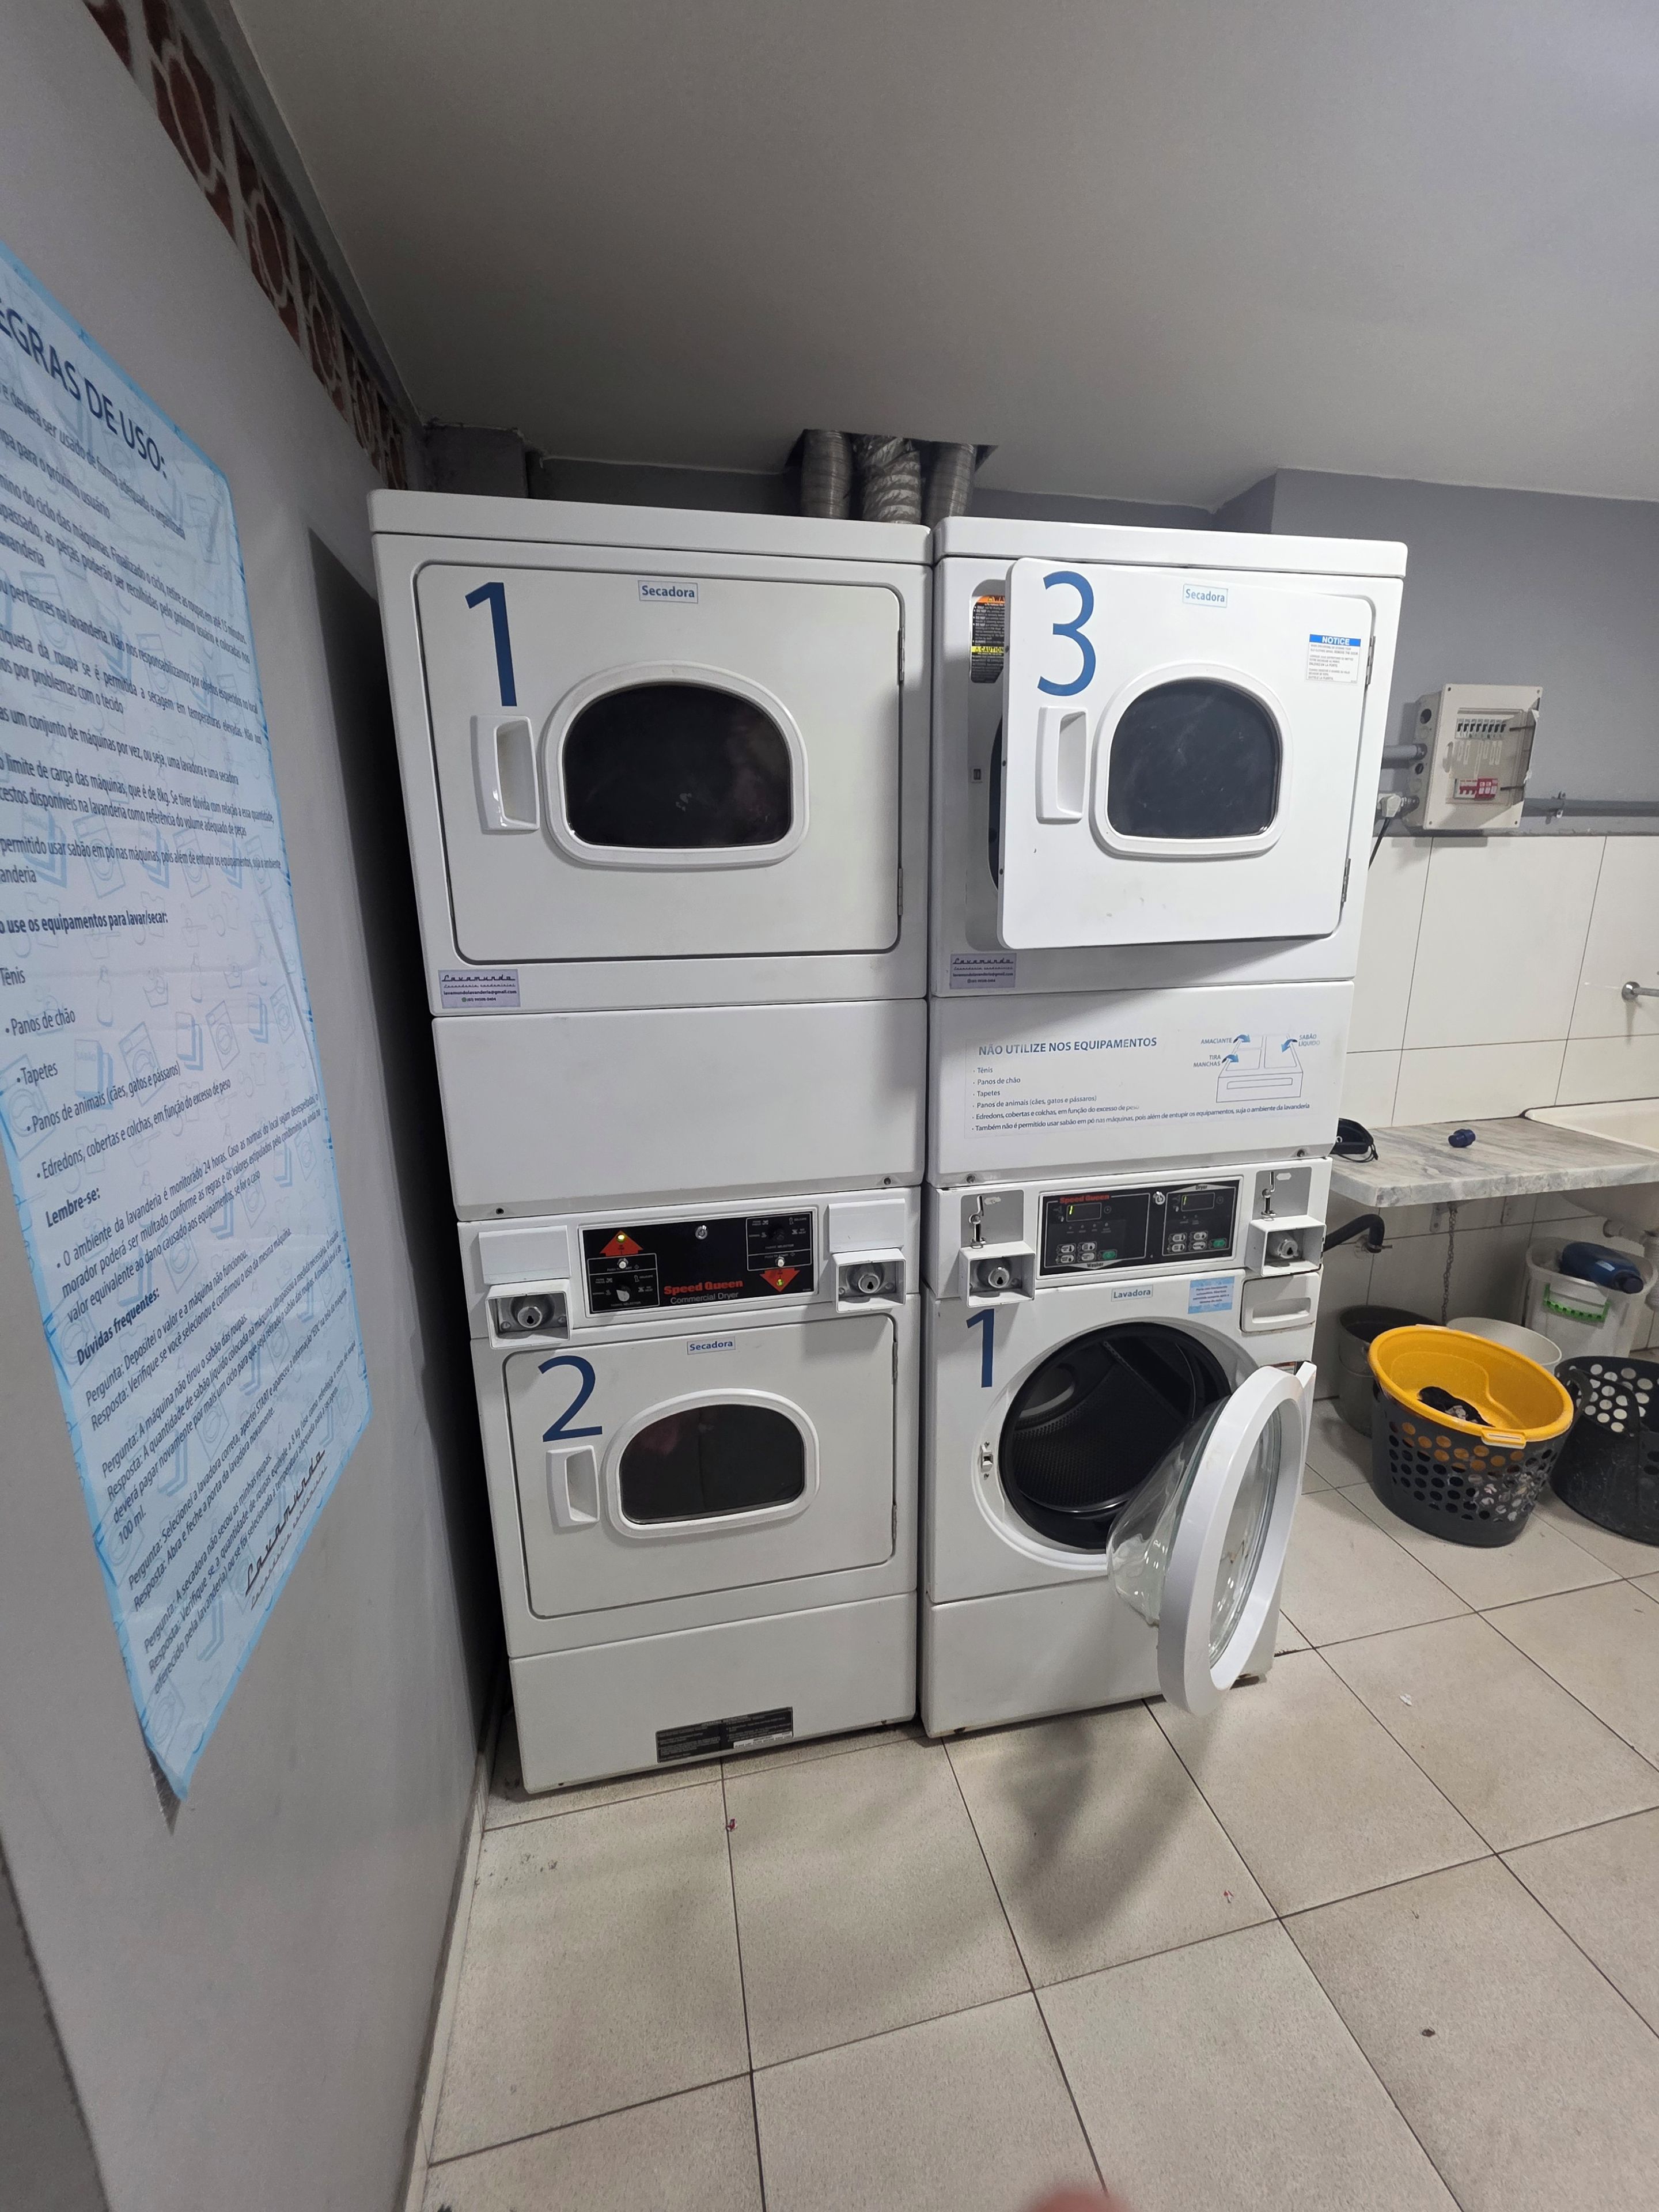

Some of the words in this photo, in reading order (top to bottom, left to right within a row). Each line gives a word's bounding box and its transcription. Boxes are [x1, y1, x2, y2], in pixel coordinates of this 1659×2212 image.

[84, 377, 118, 435] DE
[119, 409, 167, 480] USO:
[642, 585, 695, 599] Secadora
[1185, 588, 1226, 603] Secadora
[464, 581, 518, 707] 1
[1037, 570, 1096, 696] 3
[1322, 636, 1350, 645] NOTICE
[12, 709, 28, 728] um
[29, 715, 67, 738] conjunto
[69, 722, 80, 741] de
[80, 728, 116, 752] máquinas
[116, 741, 128, 756] por
[129, 747, 143, 761] vez,
[143, 749, 152, 762] ou
[152, 751, 166, 768] seja,
[167, 754, 181, 770] uma
[181, 756, 203, 777] lavadora
[203, 766, 207, 777] e
[208, 767, 219, 779] uma
[219, 769, 240, 785] secadora
[5, 752, 35, 777] limite
[36, 759, 48, 779] de
[50, 767, 74, 787] carga
[75, 768, 89, 787] das
[90, 773, 127, 798] máquinas,
[128, 784, 141, 800] que
[142, 783, 147, 798] é
[148, 785, 157, 801] de
[157, 787, 171, 806] 8kg.
[6, 917, 27, 934] use
[29, 918, 40, 932] os
[41, 912, 108, 935] equipamentos
[108, 914, 126, 931] para
[126, 910, 169, 927] lavar/secar:
[0, 965, 26, 987] Tênis
[441, 974, 516, 982] Lavamundo
[10, 1015, 41, 1037] Panos
[42, 1010, 55, 1029] de
[55, 1005, 76, 1027] chão
[979, 1044, 1003, 1056] NÃO
[1005, 1043, 1046, 1055] UTILIZE
[1048, 1041, 1071, 1052] NOS
[1074, 1037, 1157, 1051] EQUIPAMENTOS
[20, 1062, 59, 1088] Tapetes
[32, 1111, 60, 1133] Panos
[62, 1103, 74, 1122] de
[74, 1092, 105, 1116] animais
[107, 1085, 128, 1105] (cães,
[128, 1074, 148, 1098] gatos
[153, 1060, 181, 1088] pássaros)
[977, 1090, 1001, 1098] Tapetes
[1029, 1097, 1046, 1106] (cães,
[1047, 1097, 1063, 1105] gatos
[1069, 1095, 1097, 1104] pássaros)
[976, 1112, 1004, 1120] Edredons,
[1068, 1107, 1087, 1116] função
[1018, 1121, 1046, 1130] permitido
[1087, 1118, 1095, 1126] pó
[1106, 1116, 1134, 1124] máquinas,
[1169, 1111, 1188, 1119] entupir
[1196, 1108, 1234, 1118] equipamentos,
[1236, 1107, 1245, 1115] suja
[41, 1147, 86, 1180] Edredons,
[86, 1130, 120, 1158] cobertas
[120, 1129, 126, 1141] e
[127, 1117, 153, 1138] colchas,
[153, 1110, 164, 1125] em
[164, 1099, 185, 1121] função
[185, 1094, 193, 1109] do
[193, 1087, 213, 1105] excesso
[213, 1081, 219, 1096] de
[219, 1078, 231, 1097] peso
[46, 1187, 101, 1228] Lembre-se:
[63, 1249, 71, 1267] O
[73, 1224, 112, 1261] ambiente
[114, 1217, 125, 1234] da
[125, 1192, 162, 1226] lavanderia
[164, 1186, 168, 1201] é
[169, 1167, 203, 1195] monitorado
[203, 1161, 211, 1175] 24
[211, 1152, 228, 1170] horas.
[1059, 1195, 1084, 1205] Speed
[1084, 1194, 1109, 1202] Queen
[664, 1282, 703, 1296] Speed
[704, 1280, 743, 1290] Queen
[670, 1294, 716, 1305] Commercial
[718, 1291, 739, 1300] Dryer
[1113, 1289, 1152, 1299] Lavadora
[76, 1327, 114, 1366] Dúvidas
[113, 1288, 160, 1334] frequentes:
[85, 1364, 124, 1407] Pergunta:
[123, 1330, 157, 1370] Depositei
[157, 1328, 161, 1339] o
[161, 1312, 177, 1334] valor
[178, 1308, 183, 1319] e
[184, 1302, 188, 1315] a
[188, 1281, 213, 1311] máquina
[213, 1270, 224, 1289] não
[222, 1249, 248, 1278] funcionou.
[690, 1340, 733, 1351] Secadora
[965, 1308, 995, 1388] 1
[537, 1355, 603, 1442] 2
[118, 1520, 134, 1546] 100
[134, 1504, 147, 1528] ml.
[245, 1450, 325, 1598] Lavamundo
